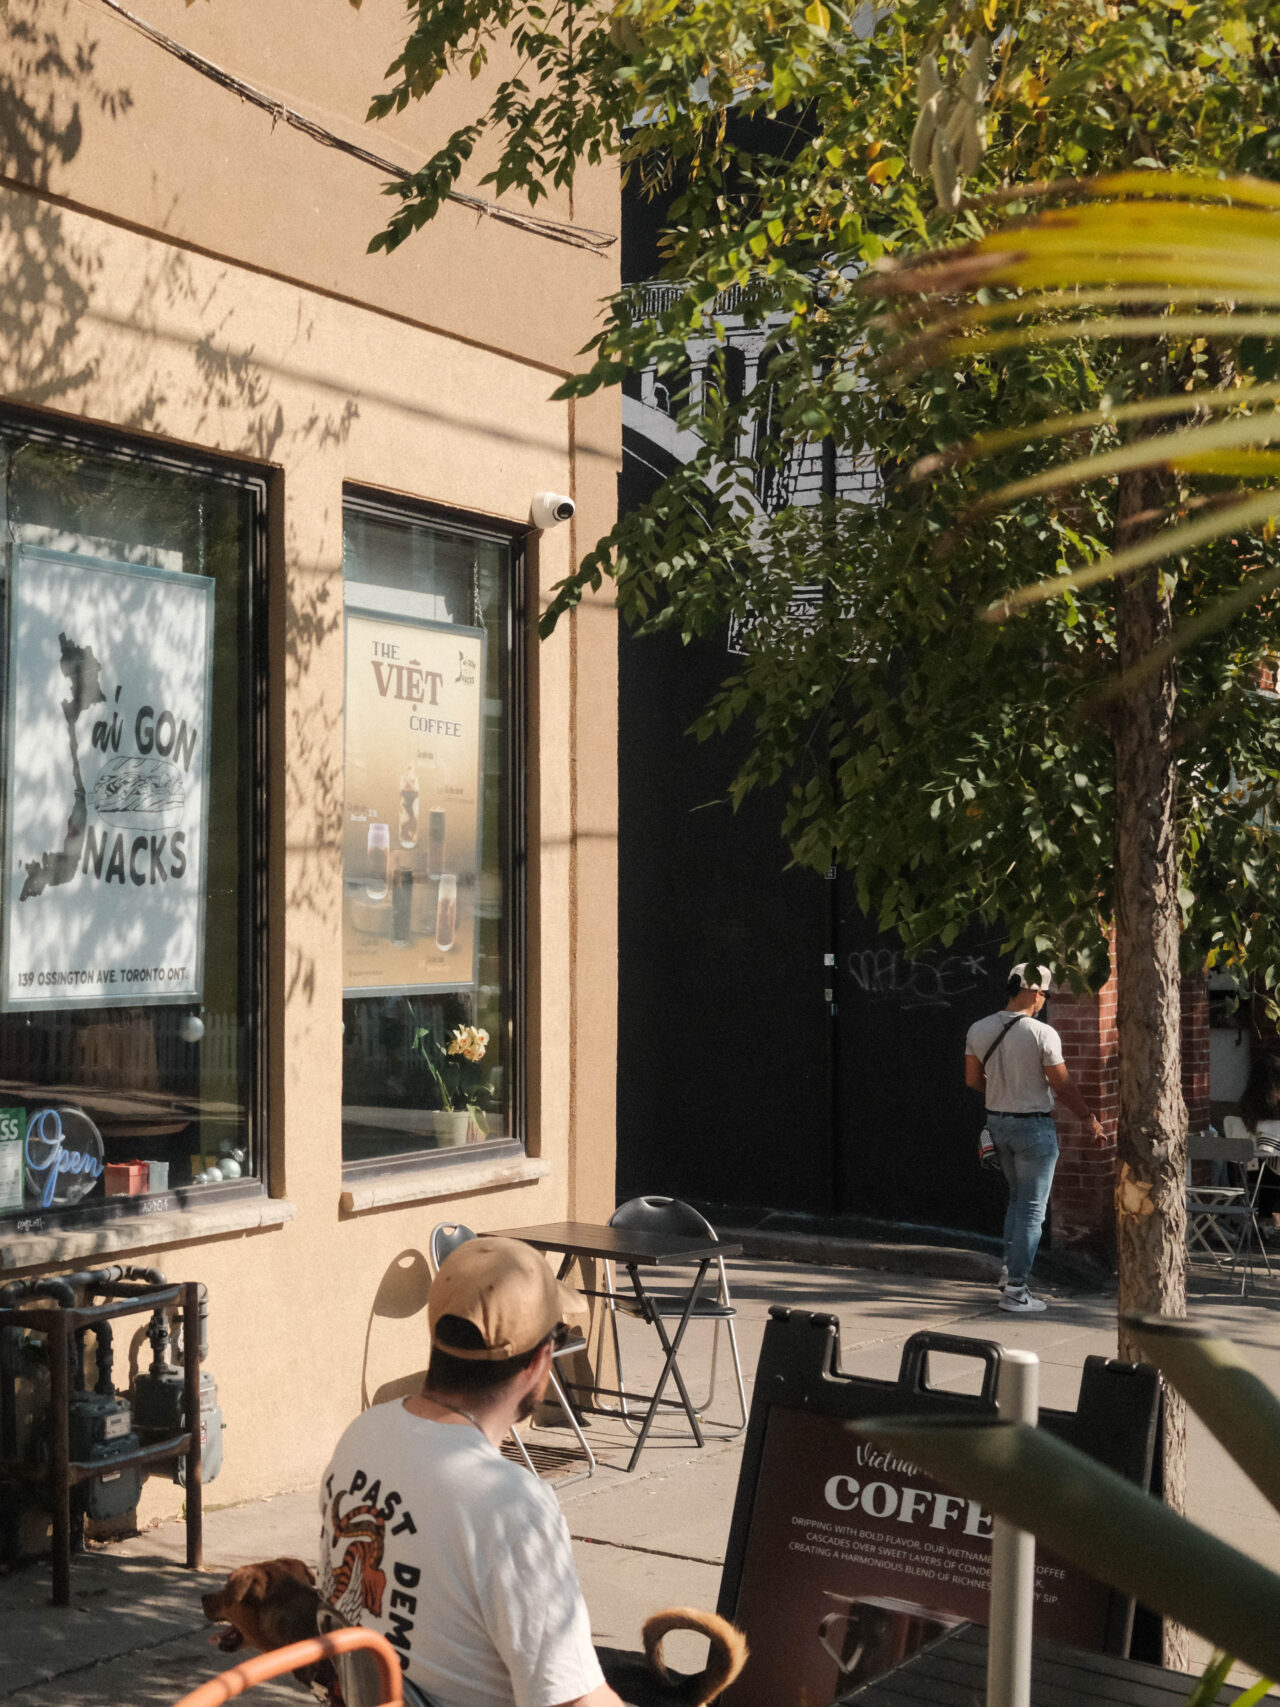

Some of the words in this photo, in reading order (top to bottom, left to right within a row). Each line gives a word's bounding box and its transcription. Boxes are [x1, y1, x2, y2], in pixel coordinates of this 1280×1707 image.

[372, 640, 401, 660] THE
[135, 705, 197, 773] GON
[409, 715, 462, 738] COFFEE
[18, 972, 35, 987] 139
[37, 970, 94, 986] OSSINGTON
[120, 967, 165, 983] TORONTO
[348, 1470, 418, 1536] PAST
[824, 1474, 994, 1539] COFFE
[788, 1541, 832, 1558] CREATING
[832, 1550, 840, 1560] A
[841, 1552, 904, 1573] HARMONIOUS
[904, 1565, 936, 1580] BLEND
[937, 1571, 950, 1582] OF
[951, 1575, 992, 1591] RICHNES
[791, 1516, 833, 1532] DRIPPING
[834, 1524, 858, 1537] WITH
[859, 1529, 884, 1542] BOLD
[923, 1542, 945, 1555] OUR
[946, 1547, 992, 1564] VIETNAME
[1035, 1564, 1066, 1580] OFFEE
[806, 1532, 851, 1549] CASCADES
[852, 1541, 876, 1553] OVER
[877, 1546, 907, 1559] SWEET
[909, 1553, 942, 1568] LAYERS
[943, 1560, 957, 1570] OF
[958, 1562, 992, 1577] CONDE
